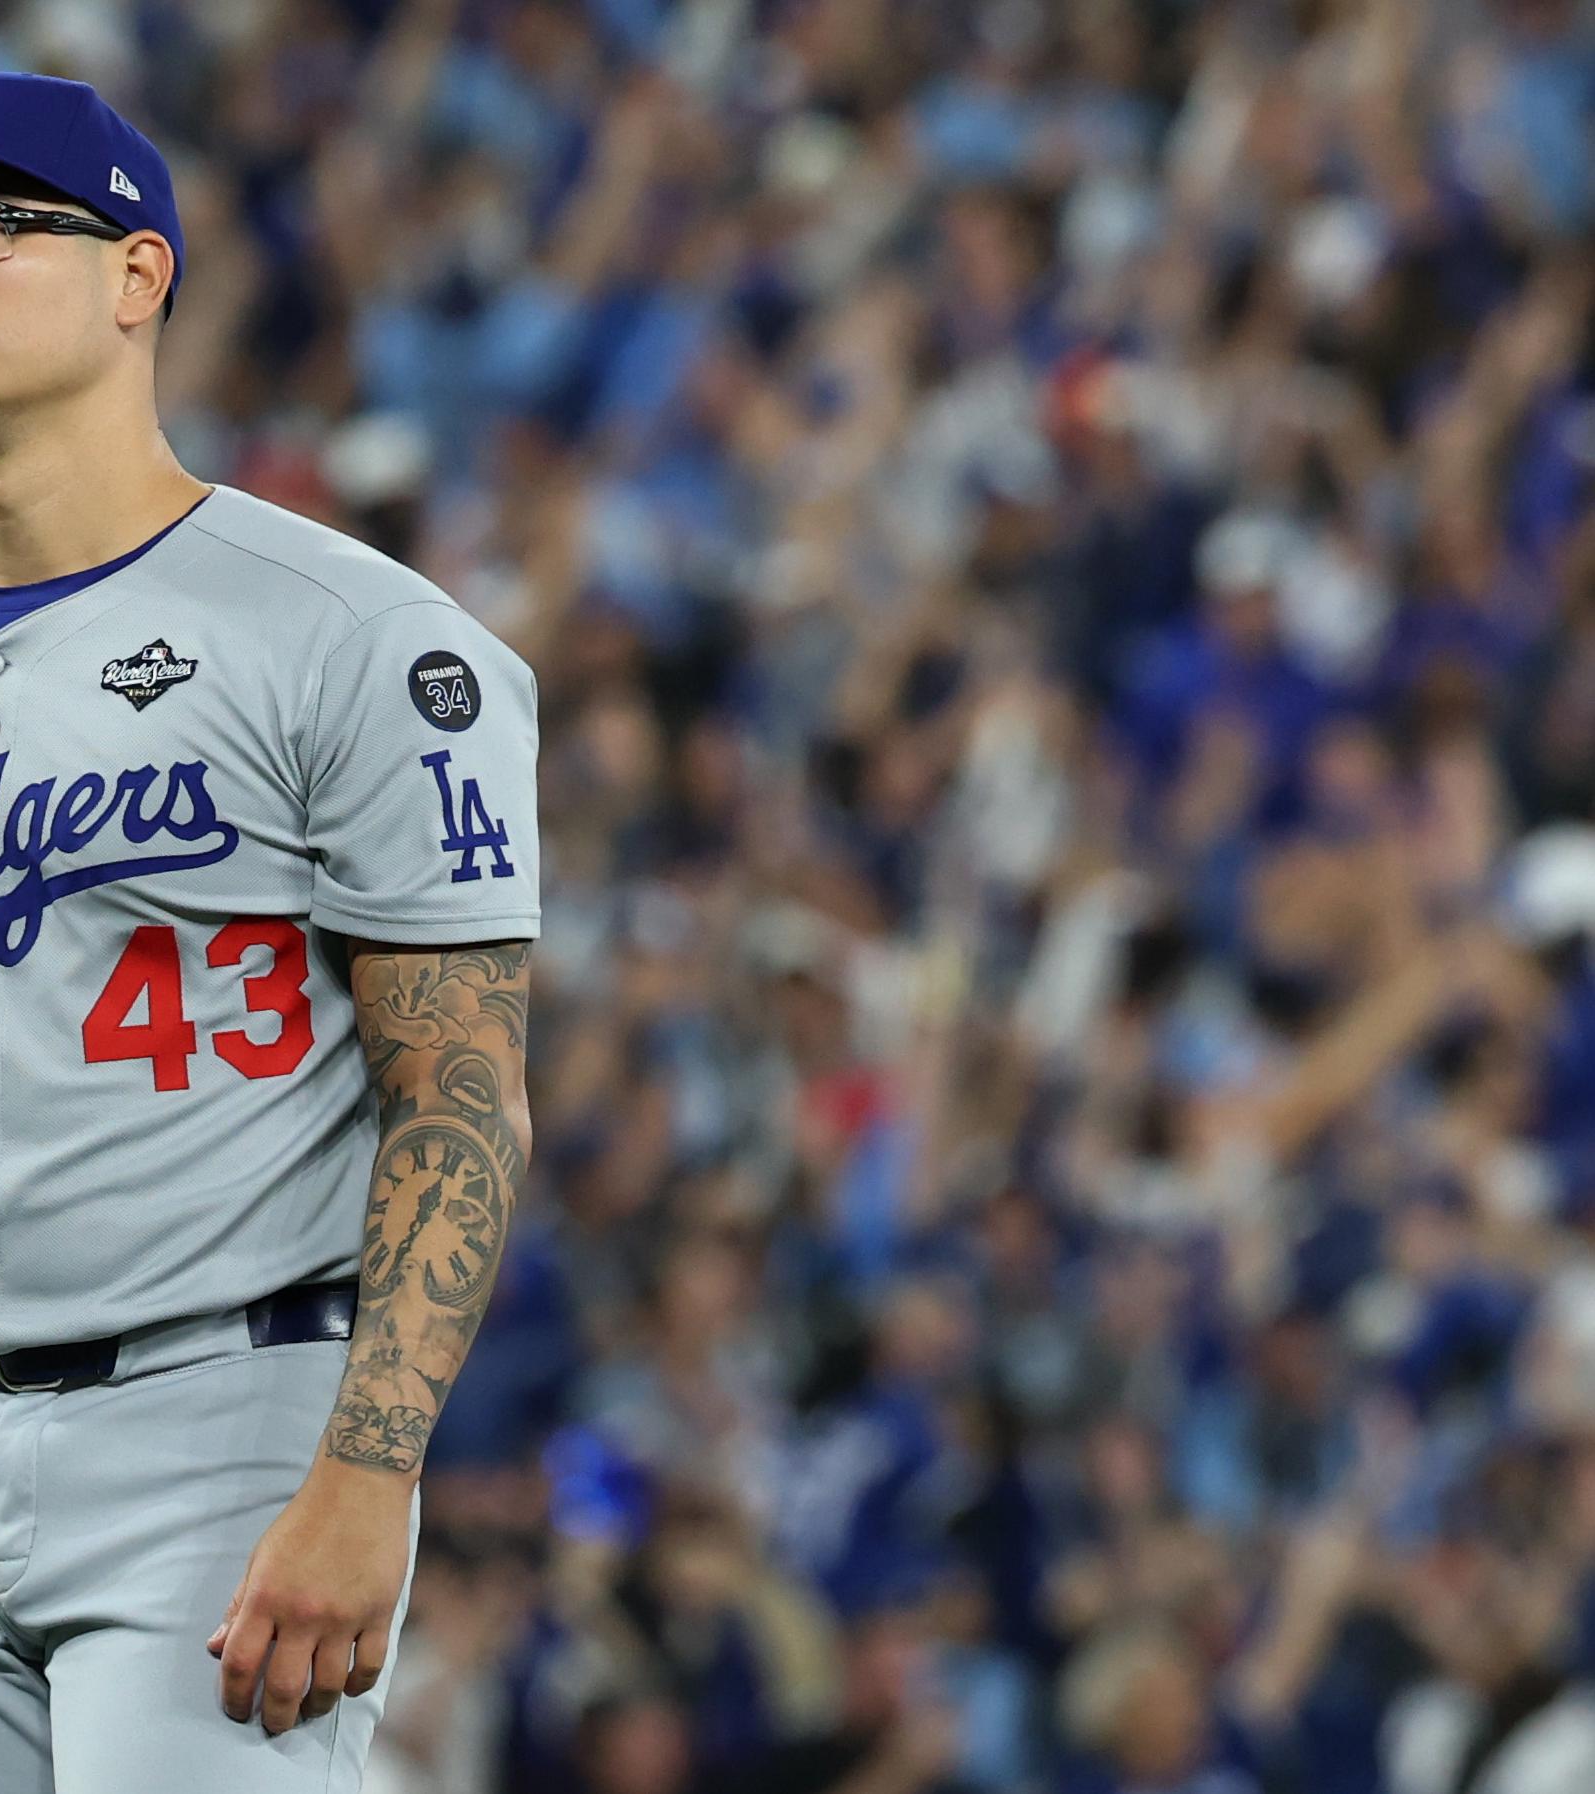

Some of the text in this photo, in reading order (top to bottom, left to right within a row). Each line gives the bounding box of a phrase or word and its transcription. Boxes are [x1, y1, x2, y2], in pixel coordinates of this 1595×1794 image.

[103, 659, 193, 688] World Series
[417, 664, 464, 682] FERNANDO
[426, 678, 471, 718] 34
[420, 749, 516, 884] LA
[82, 915, 316, 1093] 43
